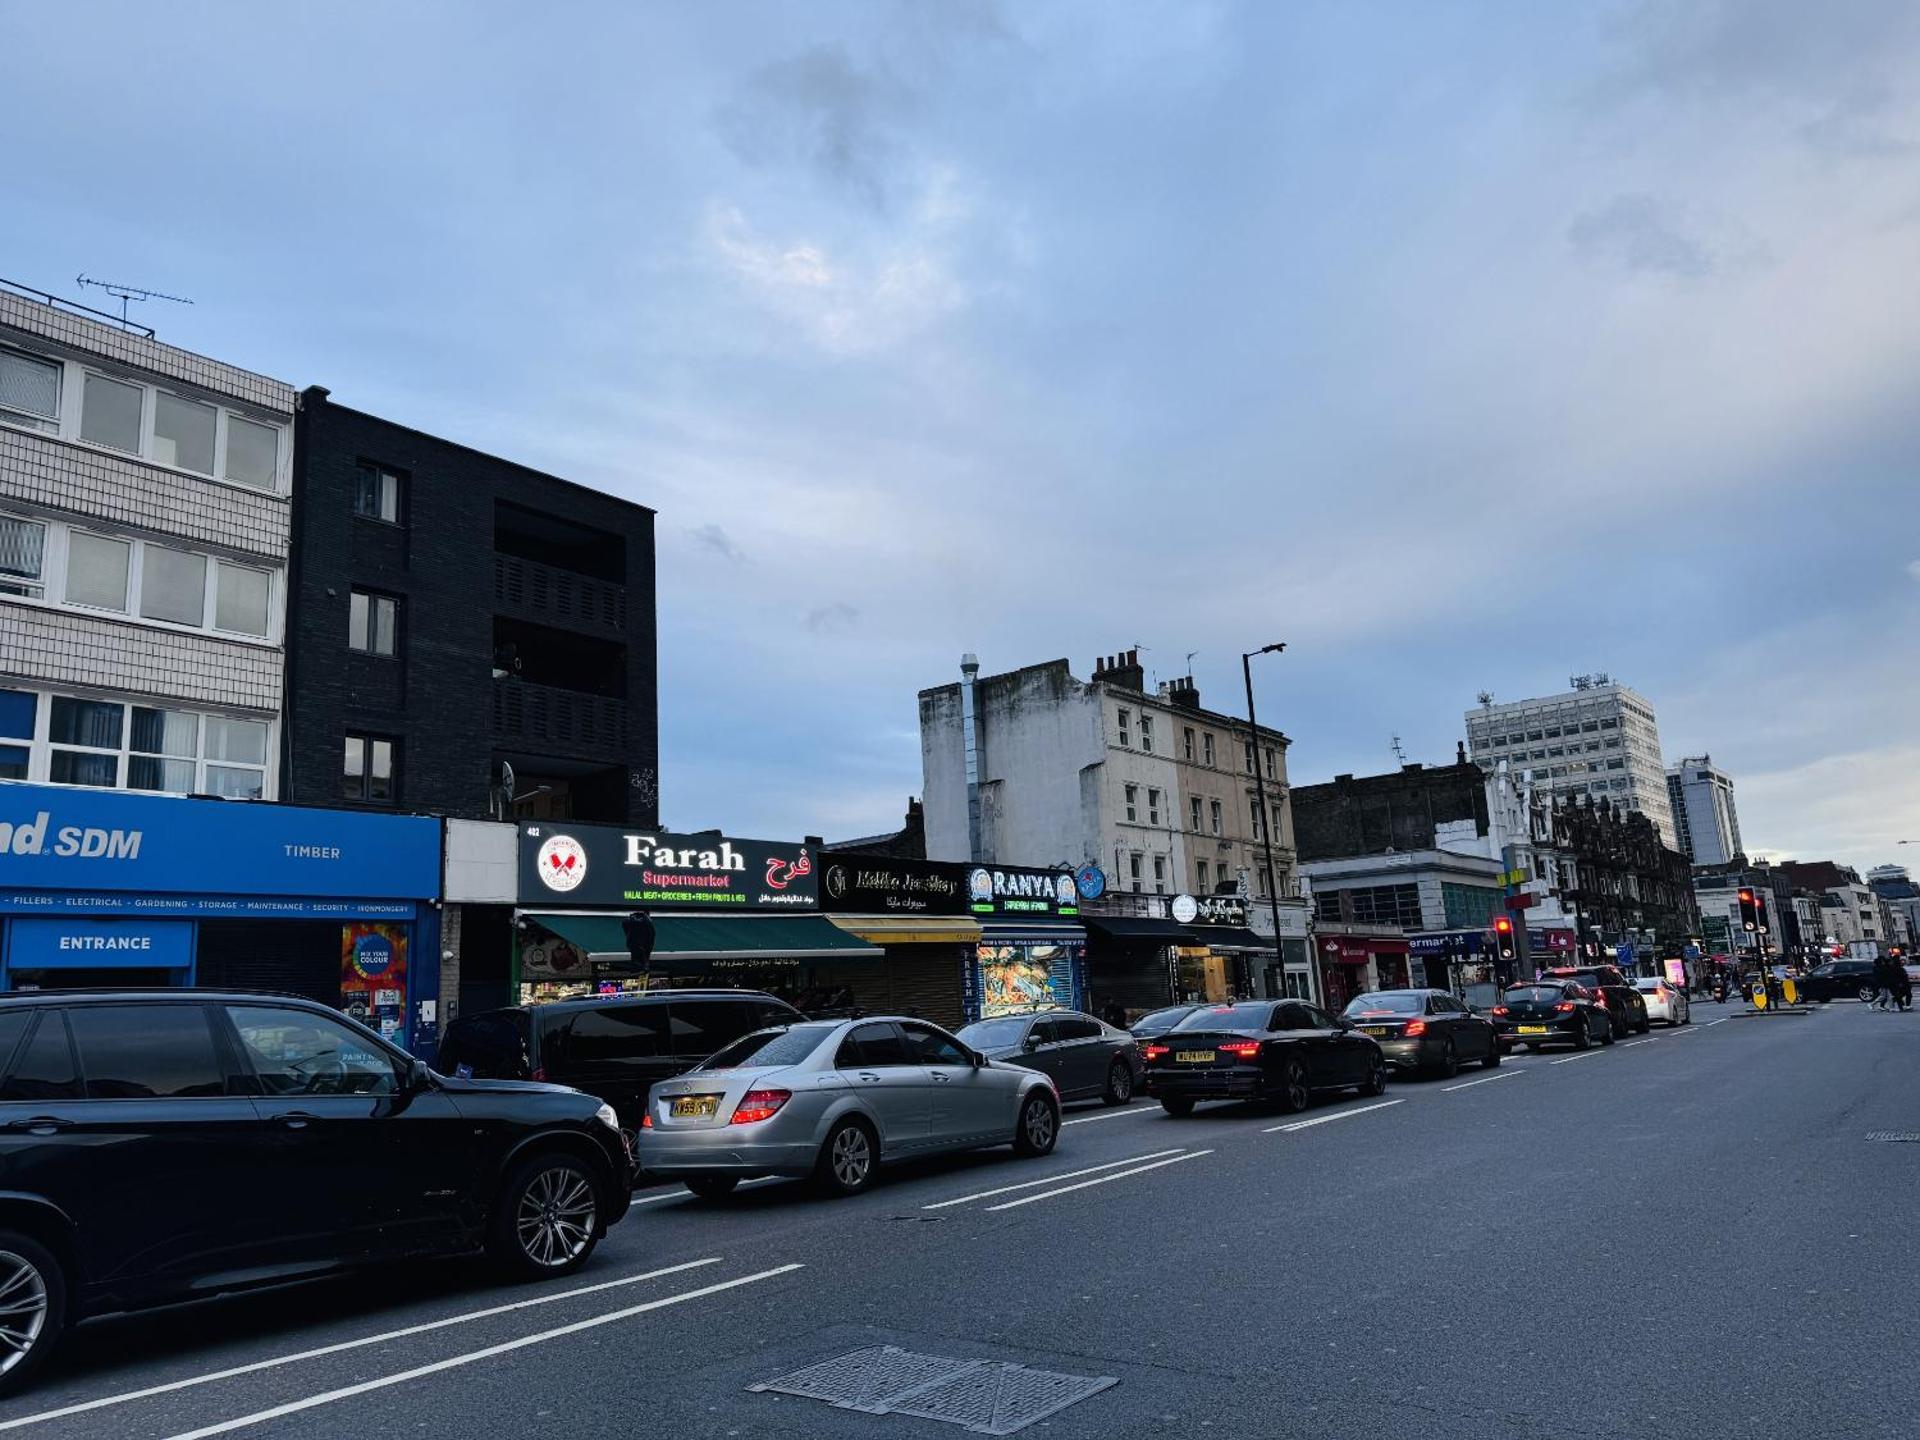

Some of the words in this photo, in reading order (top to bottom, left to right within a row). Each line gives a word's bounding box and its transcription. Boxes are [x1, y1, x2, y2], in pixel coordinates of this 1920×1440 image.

[54, 826, 143, 860] SDM
[284, 844, 341, 860] TIMBER
[623, 835, 746, 871] Farah
[765, 847, 811, 889] فرح
[642, 871, 731, 888] Supermarket
[993, 871, 1056, 898] RANYA
[13, 896, 53, 905] FILLERS
[66, 898, 123, 907] ELECTRICAL
[135, 899, 188, 908] GARDENING
[198, 900, 238, 910] STORAGE
[247, 902, 303, 911] MAINTENANCE
[312, 903, 349, 912] SECURITY
[357, 905, 409, 913] IRONMONGERY
[59, 936, 151, 950] ENTRANCE
